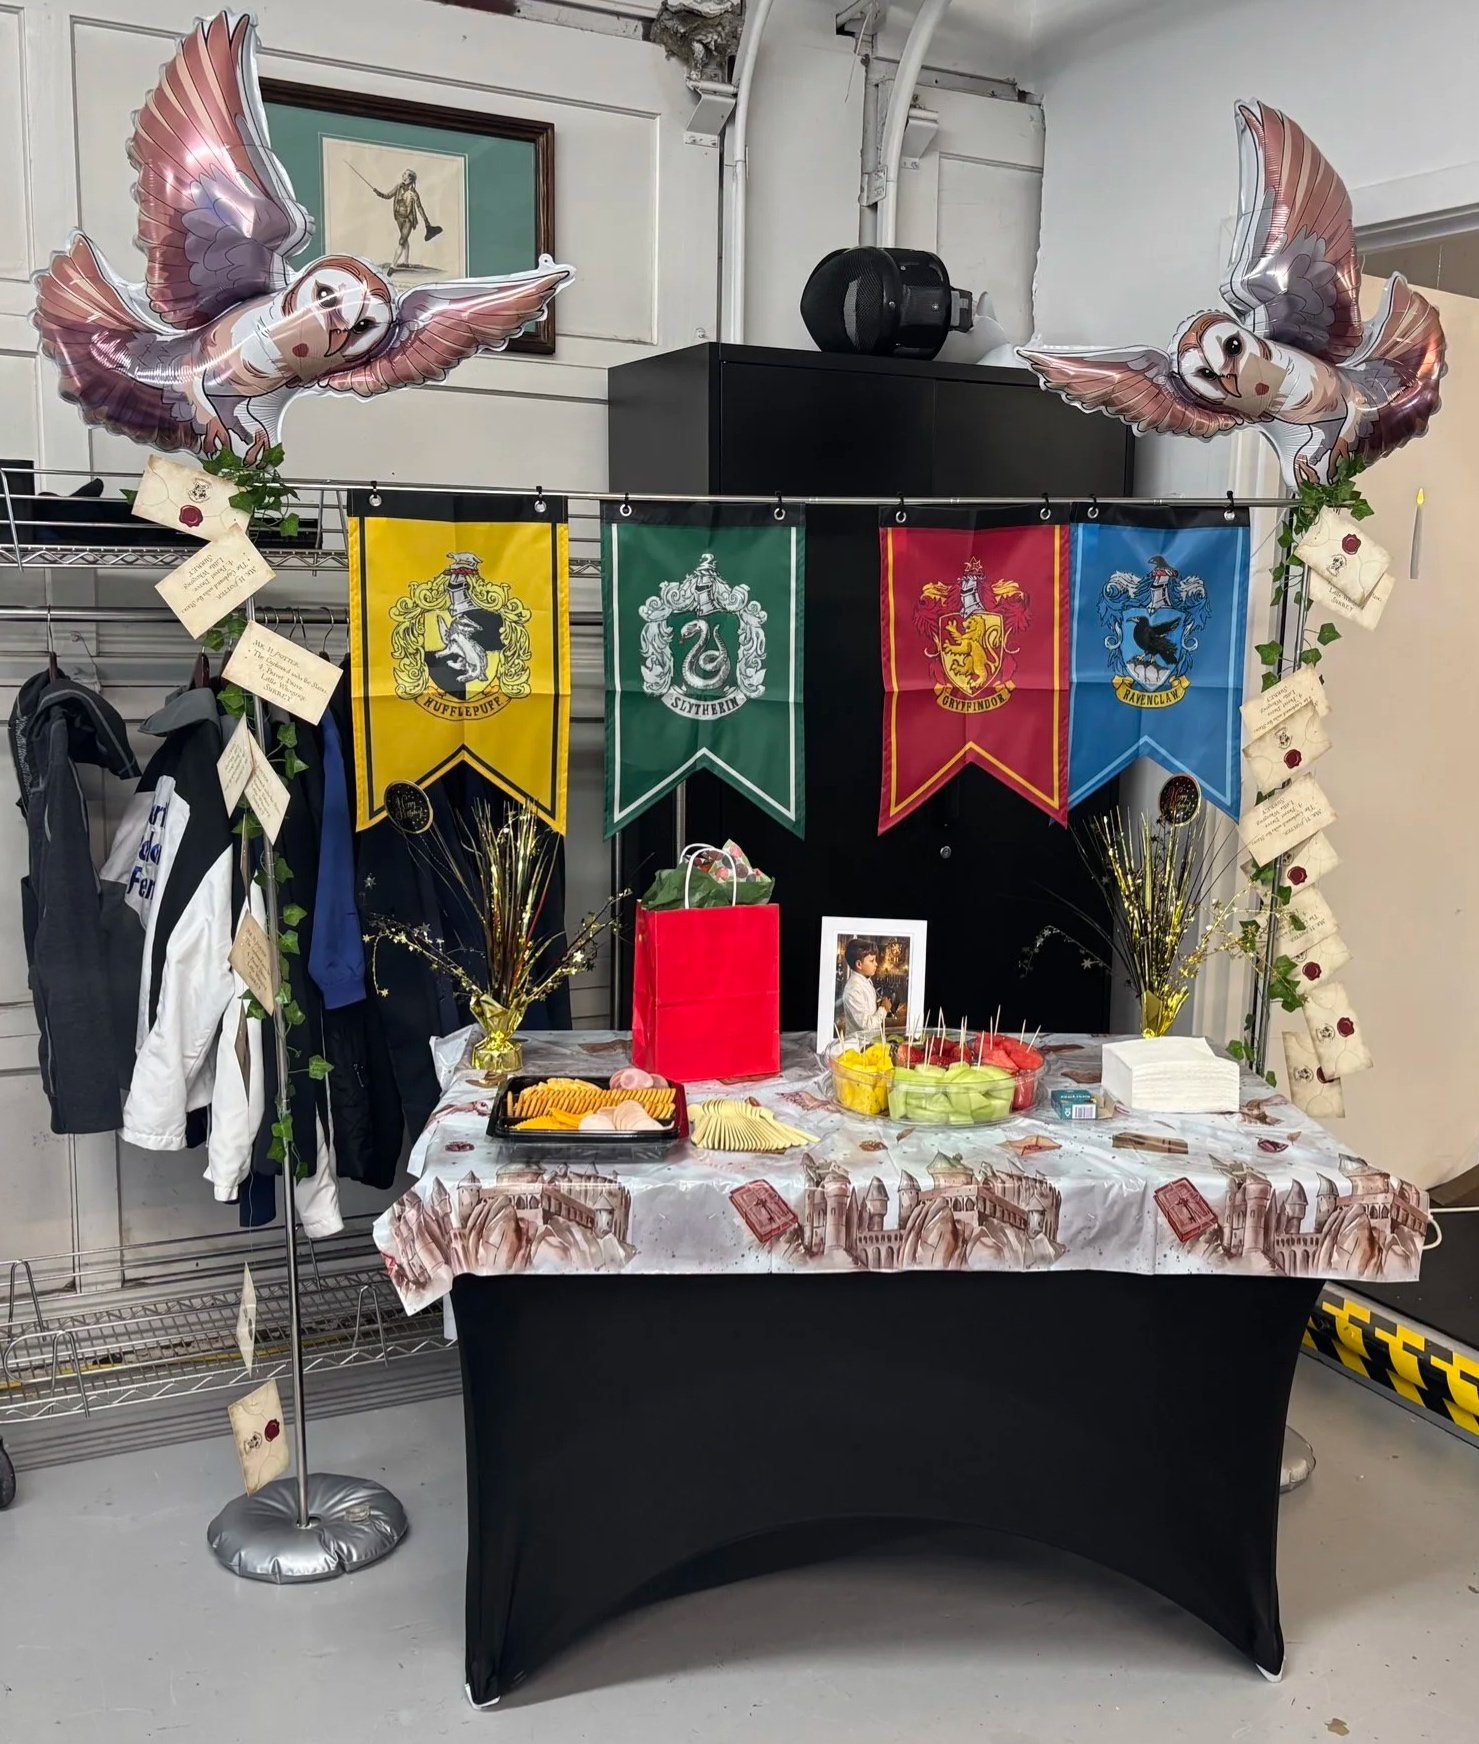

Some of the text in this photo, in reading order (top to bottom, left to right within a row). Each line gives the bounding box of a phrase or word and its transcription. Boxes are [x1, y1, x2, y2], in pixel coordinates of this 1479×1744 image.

[424, 696, 503, 717] HUFFLEPUFF
[671, 697, 740, 716] SLYTHERIN
[941, 692, 1006, 712] GRYFFINDOR
[1122, 688, 1180, 707] RAVENCLAW
